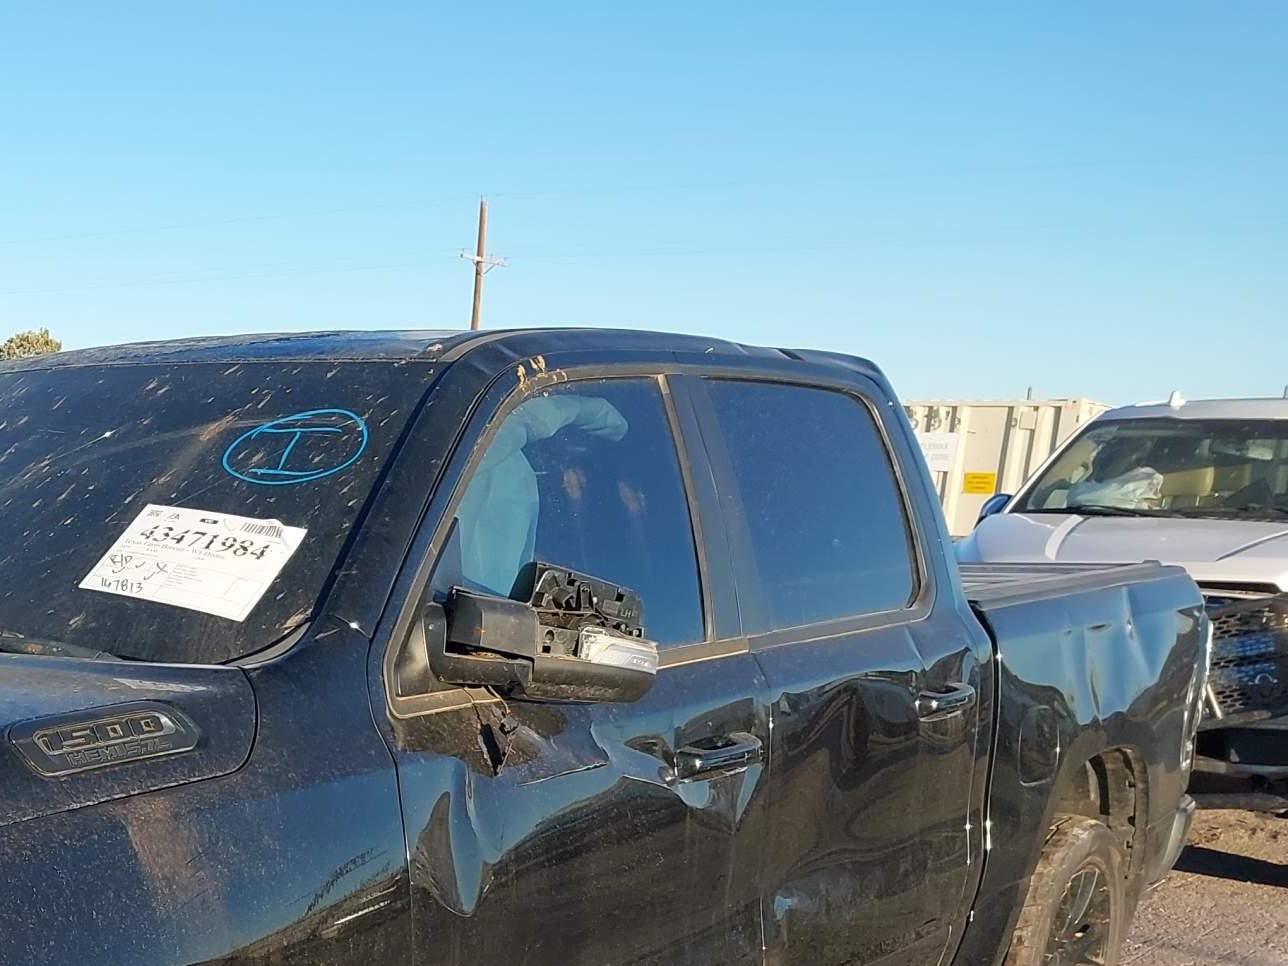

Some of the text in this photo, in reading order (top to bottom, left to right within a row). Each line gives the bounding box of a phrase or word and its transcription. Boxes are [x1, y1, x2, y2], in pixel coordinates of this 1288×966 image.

[139, 524, 272, 561] 43471984
[33, 710, 177, 756] 1500
[66, 744, 125, 766] HEMI
